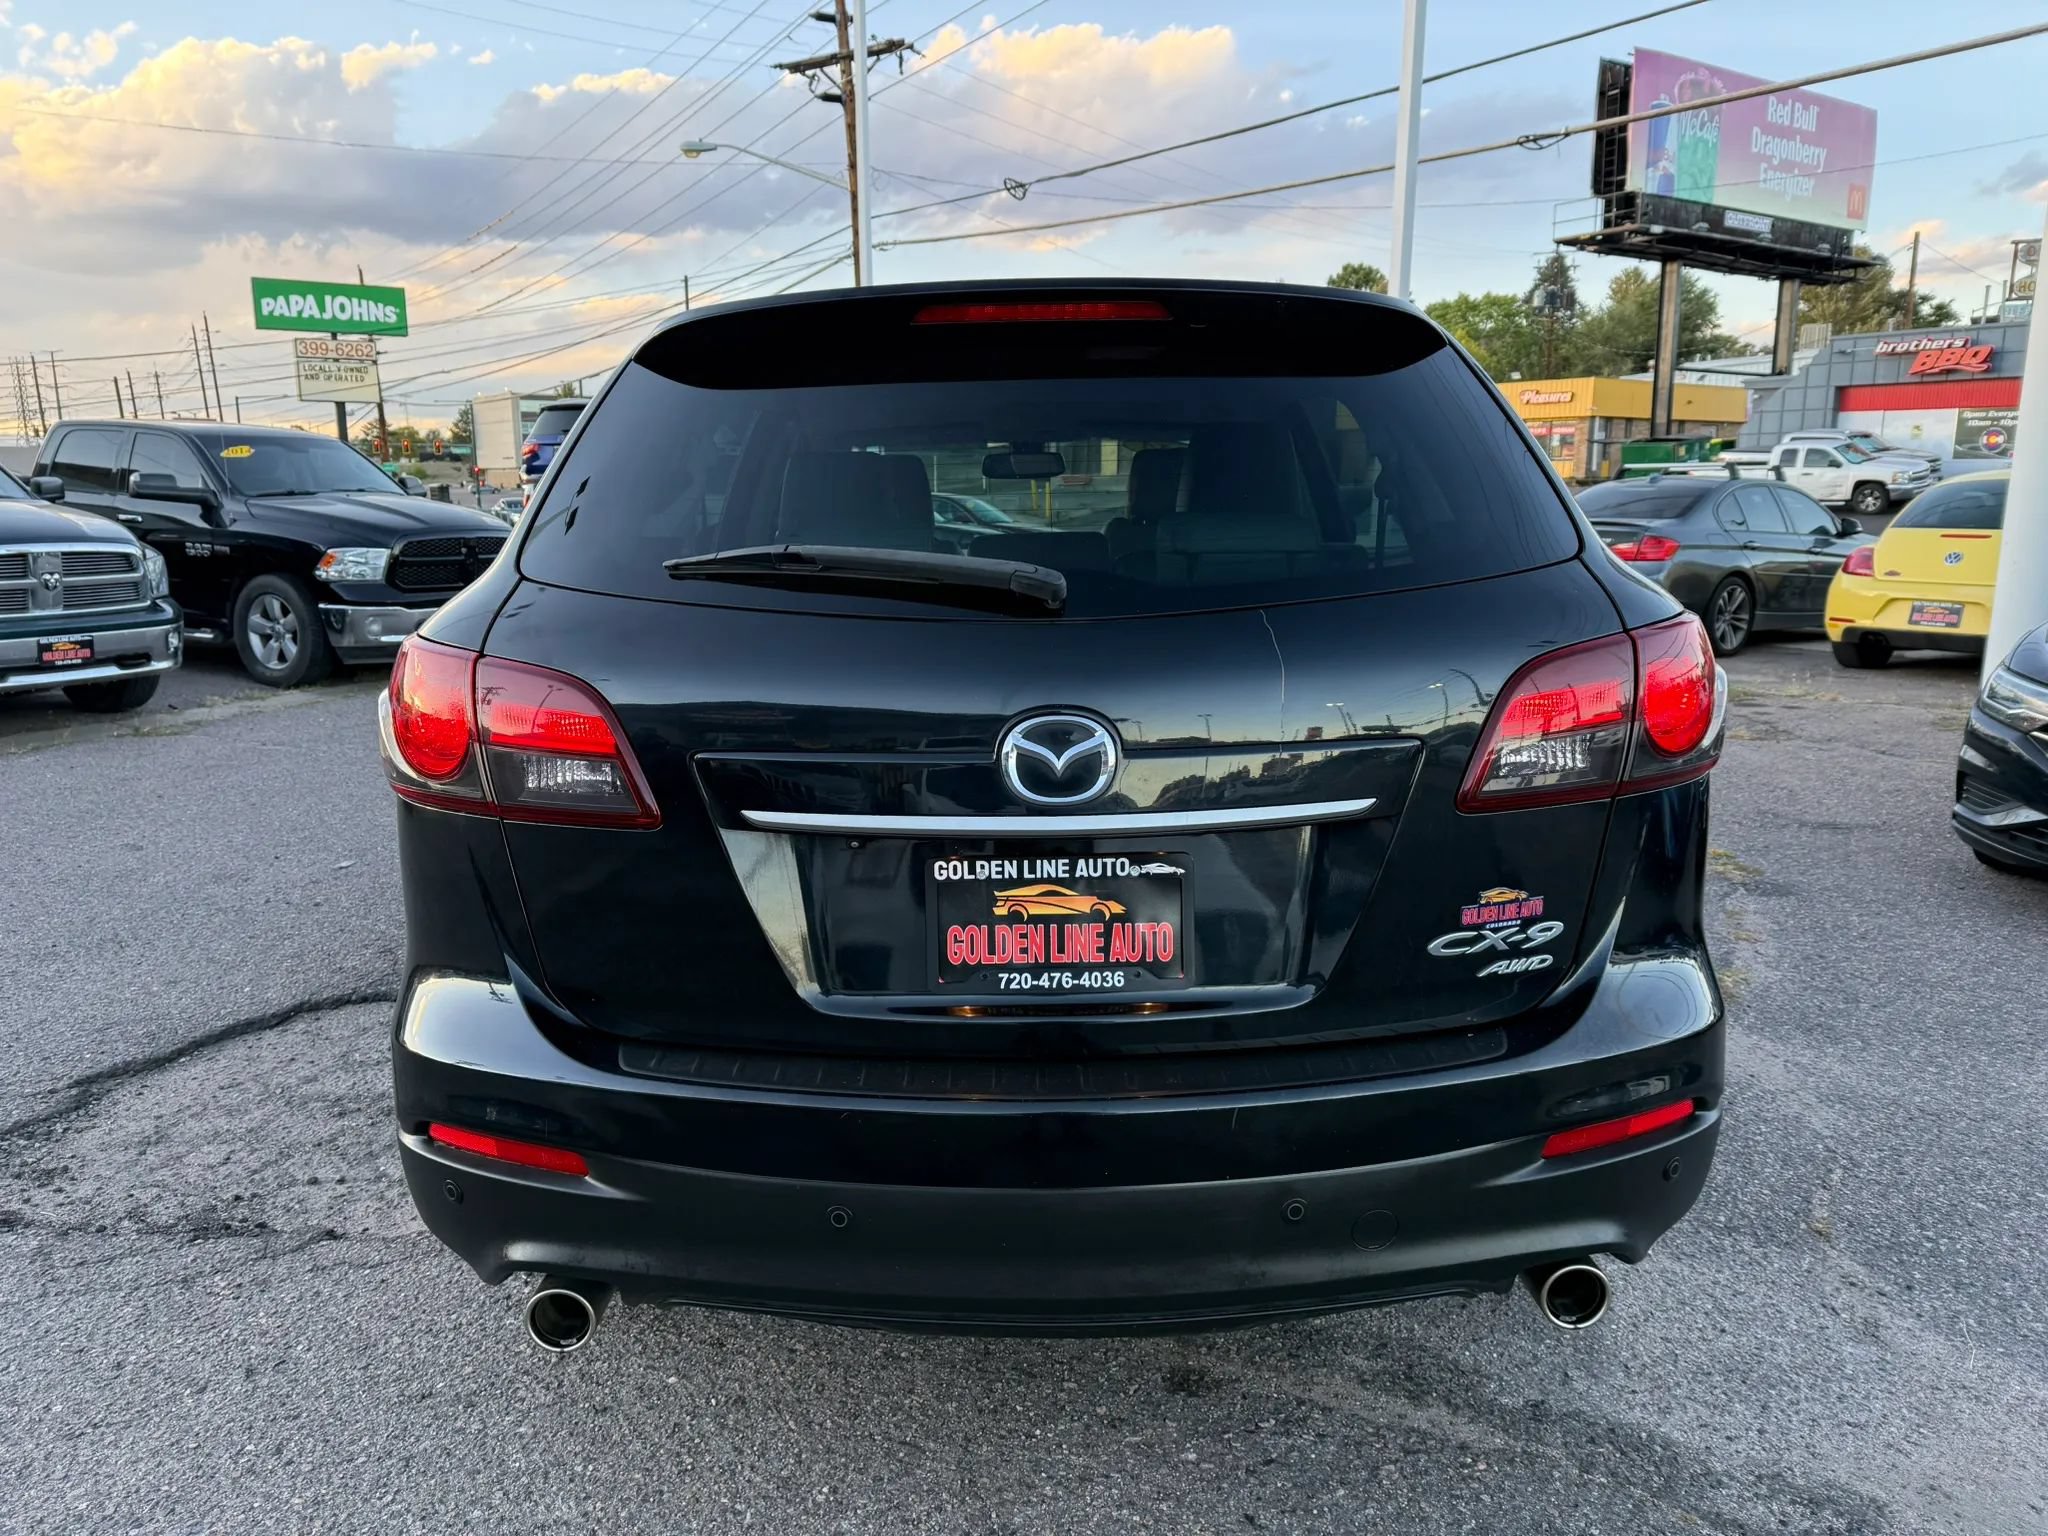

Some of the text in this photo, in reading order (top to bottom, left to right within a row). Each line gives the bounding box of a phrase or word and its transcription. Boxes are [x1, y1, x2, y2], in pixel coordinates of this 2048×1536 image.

[1768, 96, 1817, 132] Red Bull
[1752, 127, 1827, 173] Dragonberry
[1759, 163, 1815, 201] Energizer
[261, 294, 397, 323] PAPA JOHNS
[299, 341, 374, 358] 399-6262
[1875, 336, 1966, 354] brothers
[344, 366, 368, 374] OWNED
[1909, 346, 1993, 374] BBQ
[1520, 390, 1573, 404] Pleasures
[933, 857, 1130, 880] GOLDEN LINE AUTO
[1462, 898, 1544, 926] GOLDEN LINE AUTO
[1485, 920, 1521, 929] COLORADO
[947, 922, 1174, 965] GOLDEN LINE AUTO
[1427, 921, 1564, 956] CX-9
[1476, 954, 1553, 977] AWD
[998, 971, 1125, 989] 720-476-4036
